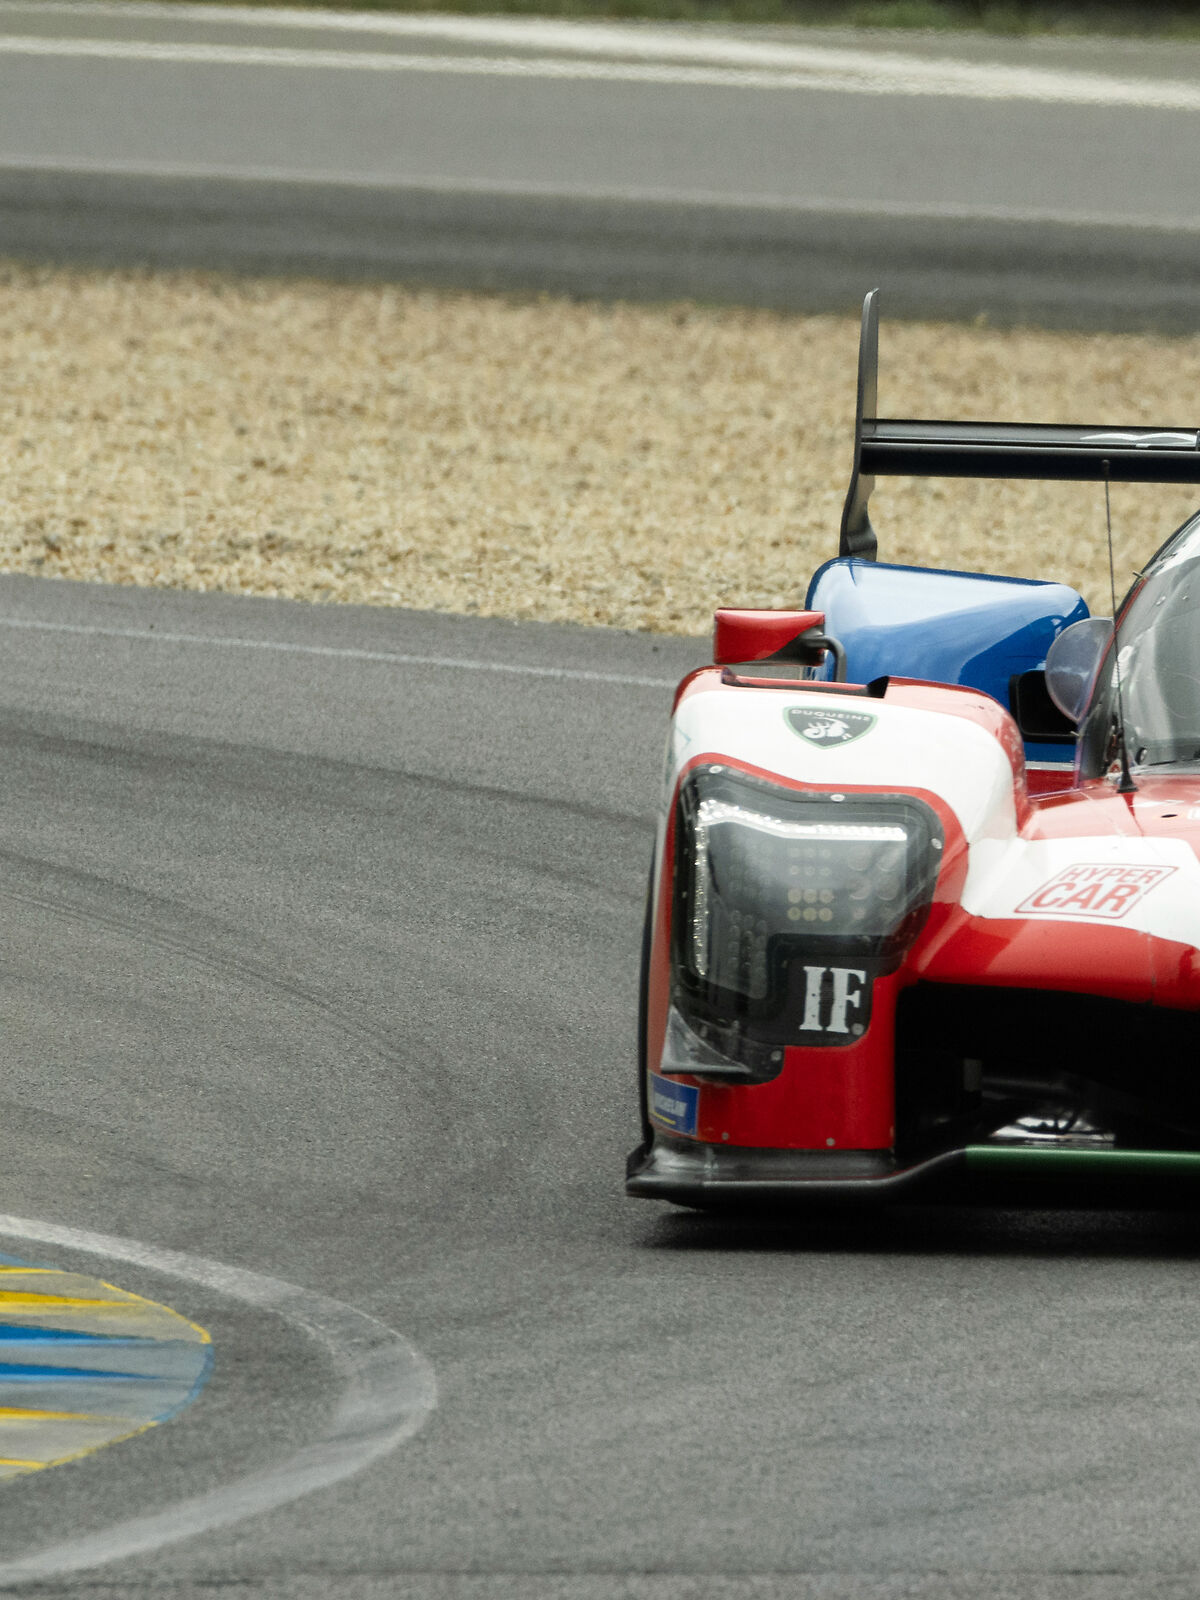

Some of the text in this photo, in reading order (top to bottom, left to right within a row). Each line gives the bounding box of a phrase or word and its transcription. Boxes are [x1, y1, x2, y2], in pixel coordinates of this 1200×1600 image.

[1059, 867, 1163, 884] HYPER
[1031, 882, 1142, 912] CAR
[799, 965, 866, 1034] IF
